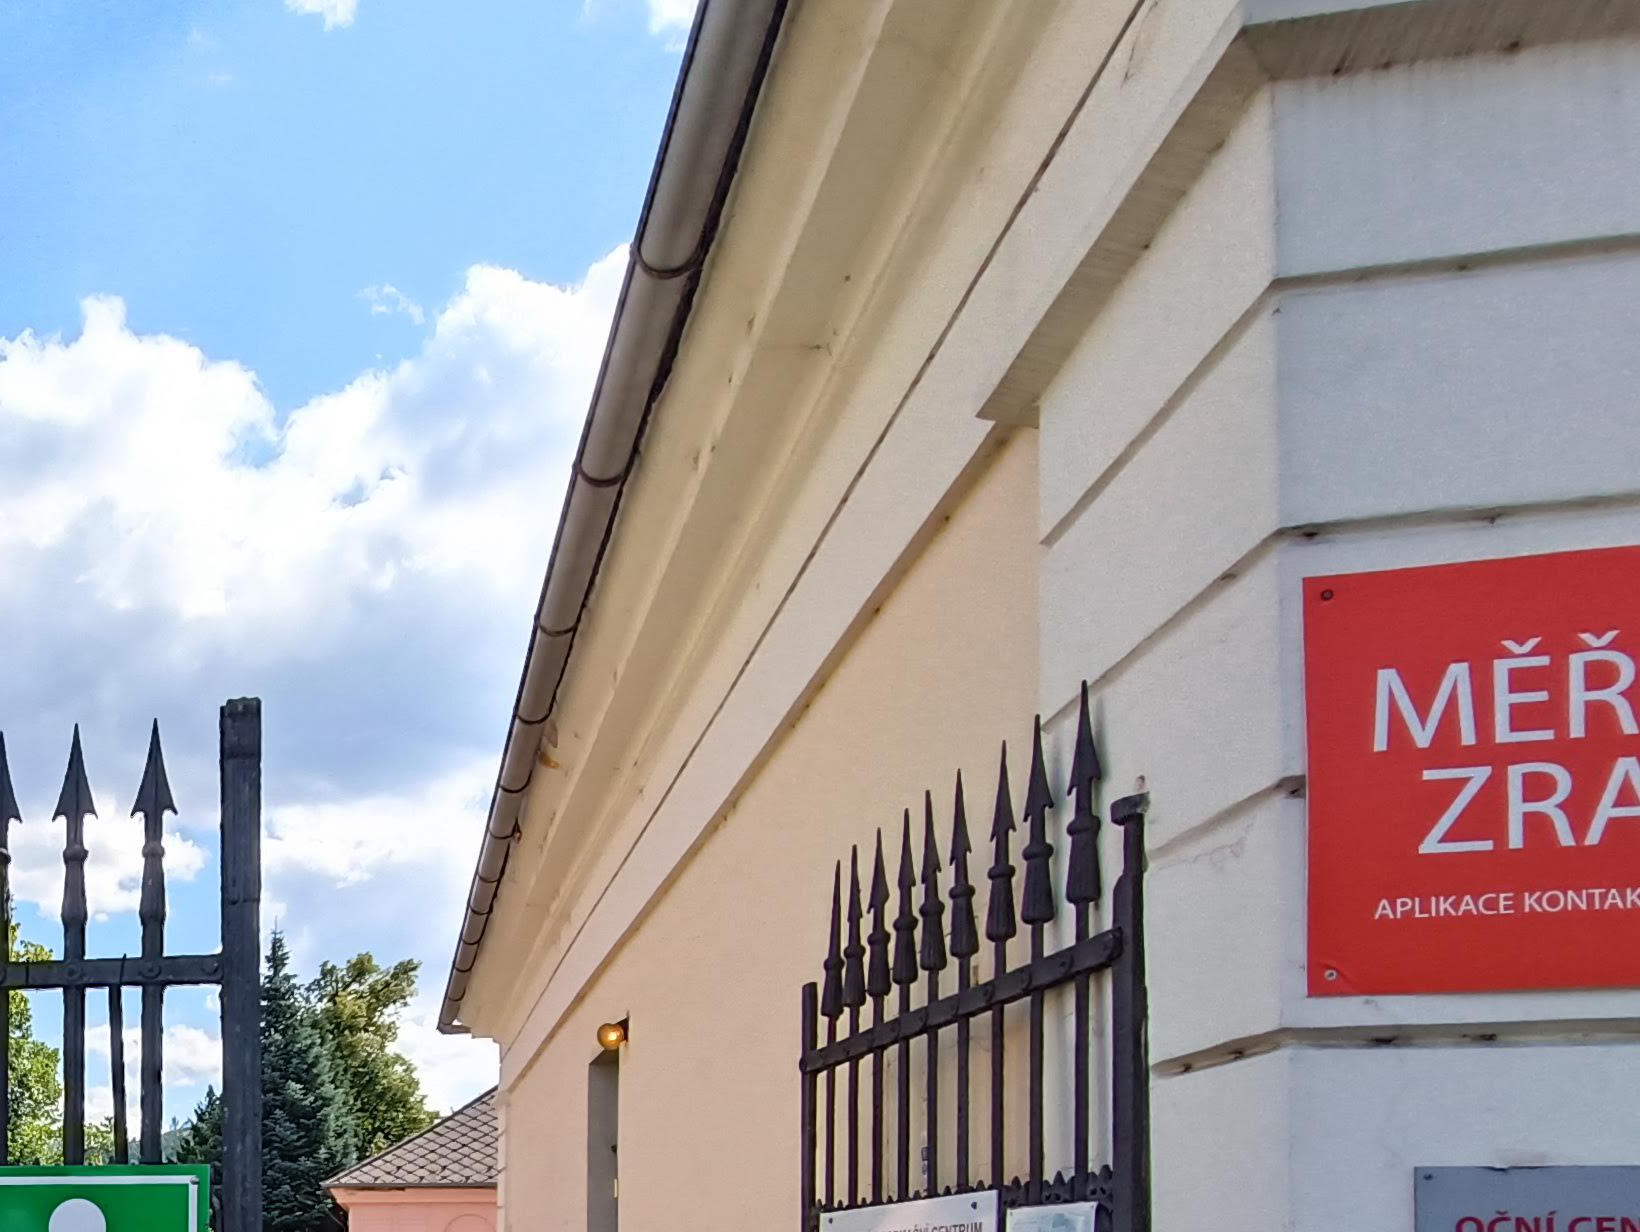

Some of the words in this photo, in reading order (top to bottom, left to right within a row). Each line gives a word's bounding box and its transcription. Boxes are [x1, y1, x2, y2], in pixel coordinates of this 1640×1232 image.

[1373, 629, 1640, 752] MĚŘ
[1418, 756, 1640, 854] ZRA
[1374, 892, 1515, 920] APLIKACE
[1524, 887, 1640, 913] KONTAK
